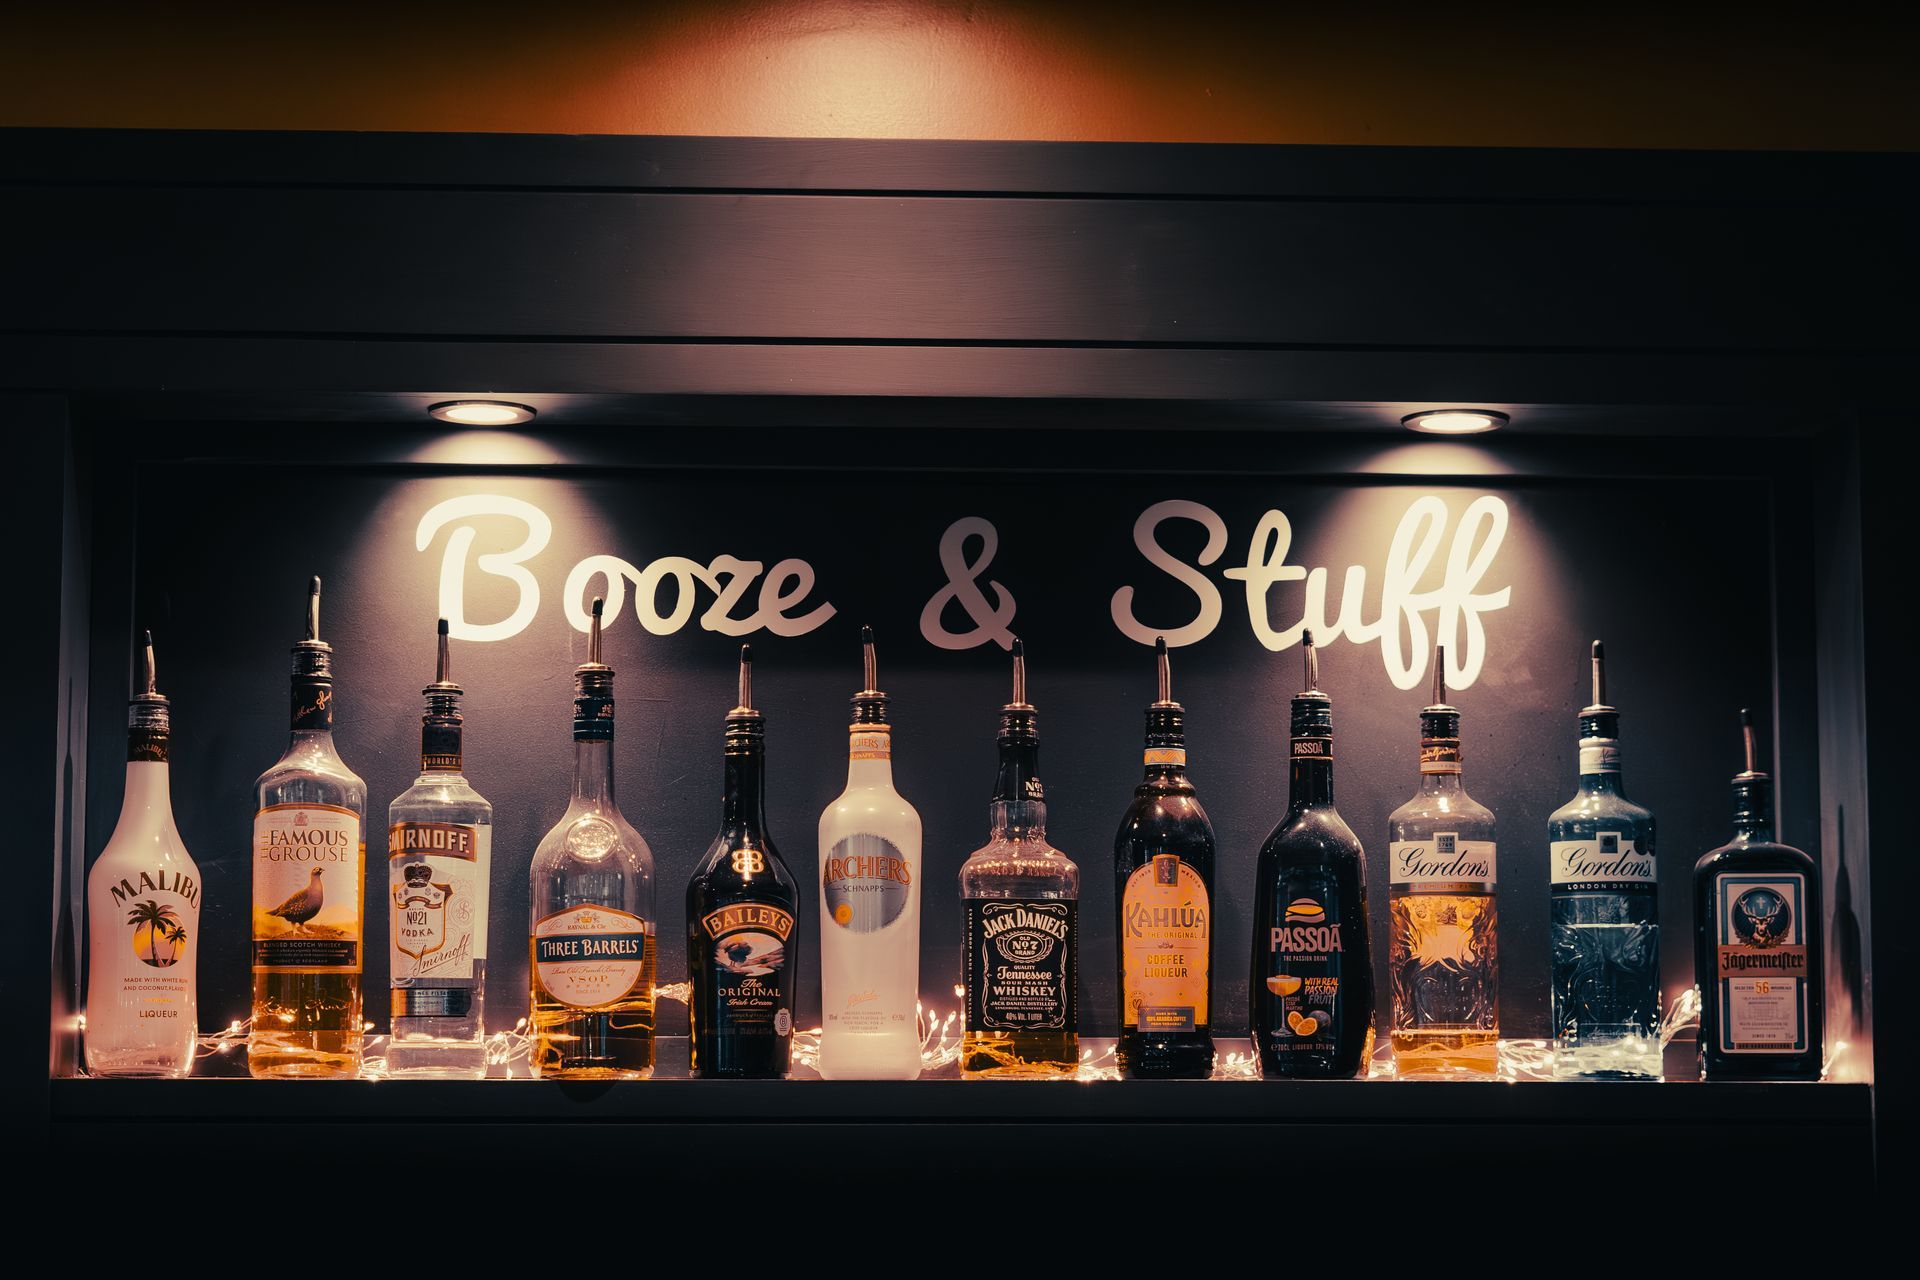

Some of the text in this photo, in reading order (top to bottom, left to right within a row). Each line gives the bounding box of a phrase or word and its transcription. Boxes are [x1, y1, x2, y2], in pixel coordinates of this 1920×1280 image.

[415, 494, 1511, 691] Booze & Stuff
[1294, 741, 1324, 754] PASSOÃ
[270, 829, 348, 847] FAMOUS
[269, 846, 348, 862] GROUSE
[1399, 848, 1490, 877] Gordon's
[1561, 850, 1653, 878] Gordon's
[110, 870, 200, 908] MALIBU
[842, 885, 885, 893] SCHNAPPS
[710, 908, 790, 933] BAILEYS
[982, 908, 1069, 940] JACK DANIEL'S
[1125, 900, 1208, 938] KAHLÚA
[401, 928, 434, 938] VODKA
[1270, 923, 1343, 953] PASSOÃ
[541, 939, 640, 958] THREE BARRELS
[1146, 954, 1185, 965] COFFEE
[1721, 951, 1805, 971] Jägermeister
[996, 965, 1053, 980] Tennessee
[1144, 967, 1188, 978] LIQUEUR
[740, 978, 763, 989] The
[1304, 977, 1339, 986] WITH REAL
[1755, 981, 1769, 994] 56
[717, 987, 781, 998] ORIGINAL
[993, 986, 1057, 997] WHISKEY
[1304, 985, 1338, 996] PASSION
[726, 998, 774, 1007] Irish Cream
[1308, 995, 1333, 1005] FRUIT
[139, 1010, 178, 1018] LIQUEUR
